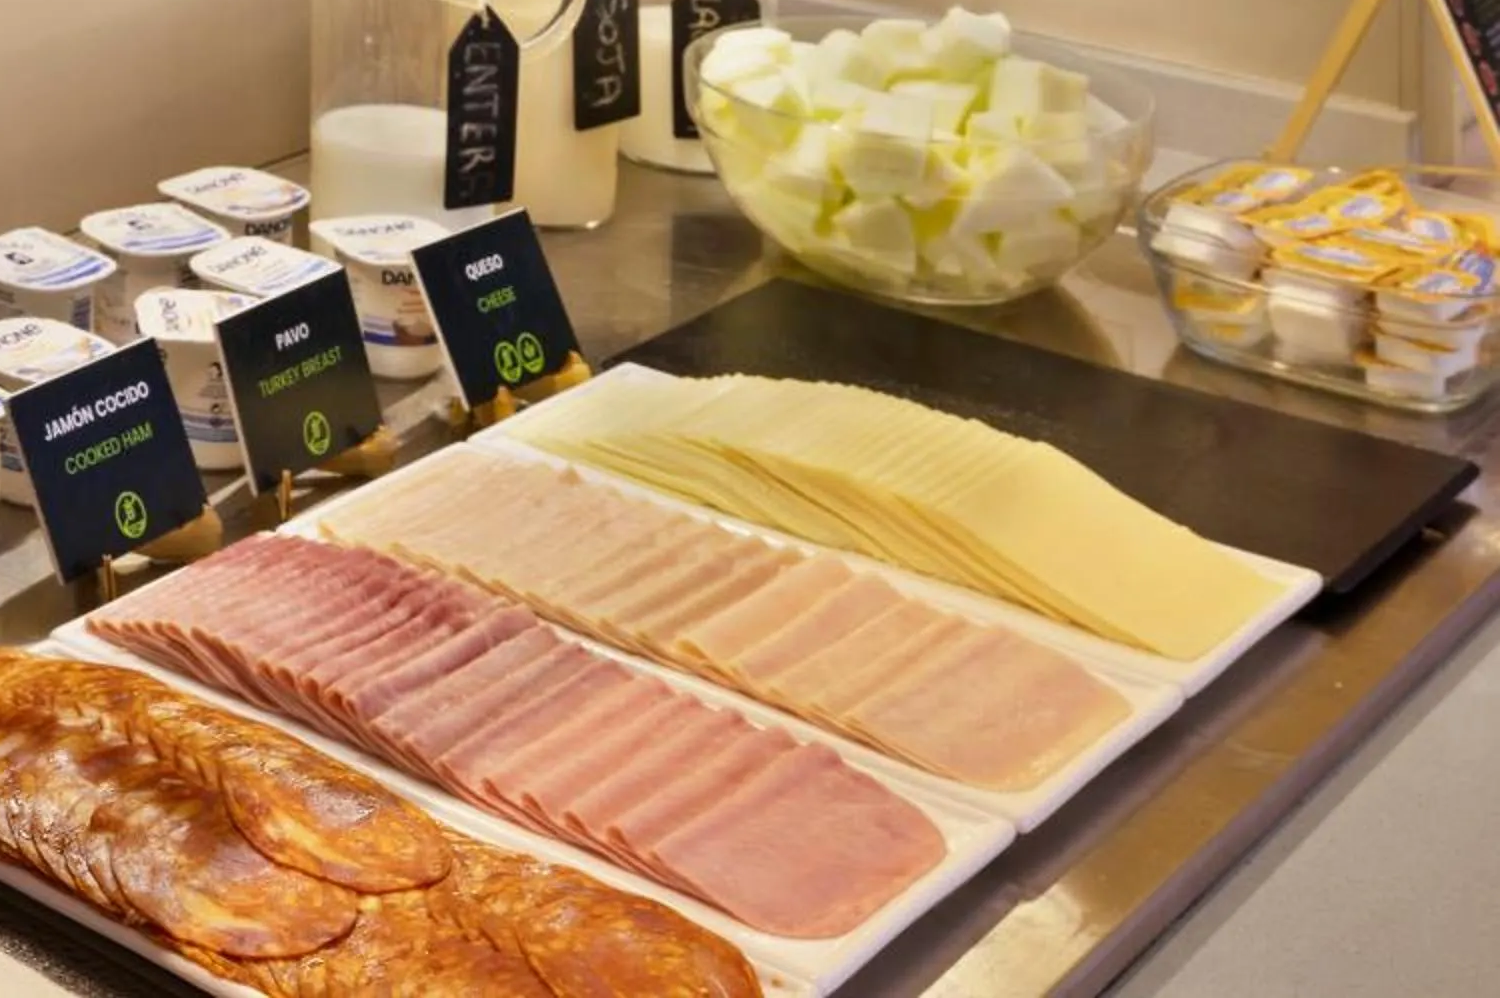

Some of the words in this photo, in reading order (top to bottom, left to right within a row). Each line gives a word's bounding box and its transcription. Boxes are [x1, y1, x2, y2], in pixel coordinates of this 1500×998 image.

[465, 254, 504, 281] QUESO
[477, 285, 517, 313] CHEESE
[275, 322, 310, 351] PAVO
[258, 364, 301, 399] TURKEY
[301, 345, 343, 378] BREAST
[44, 404, 94, 441] JAMÓN
[95, 381, 149, 419] COCIDO
[65, 437, 122, 475] COOKED
[120, 422, 154, 449] HAM
